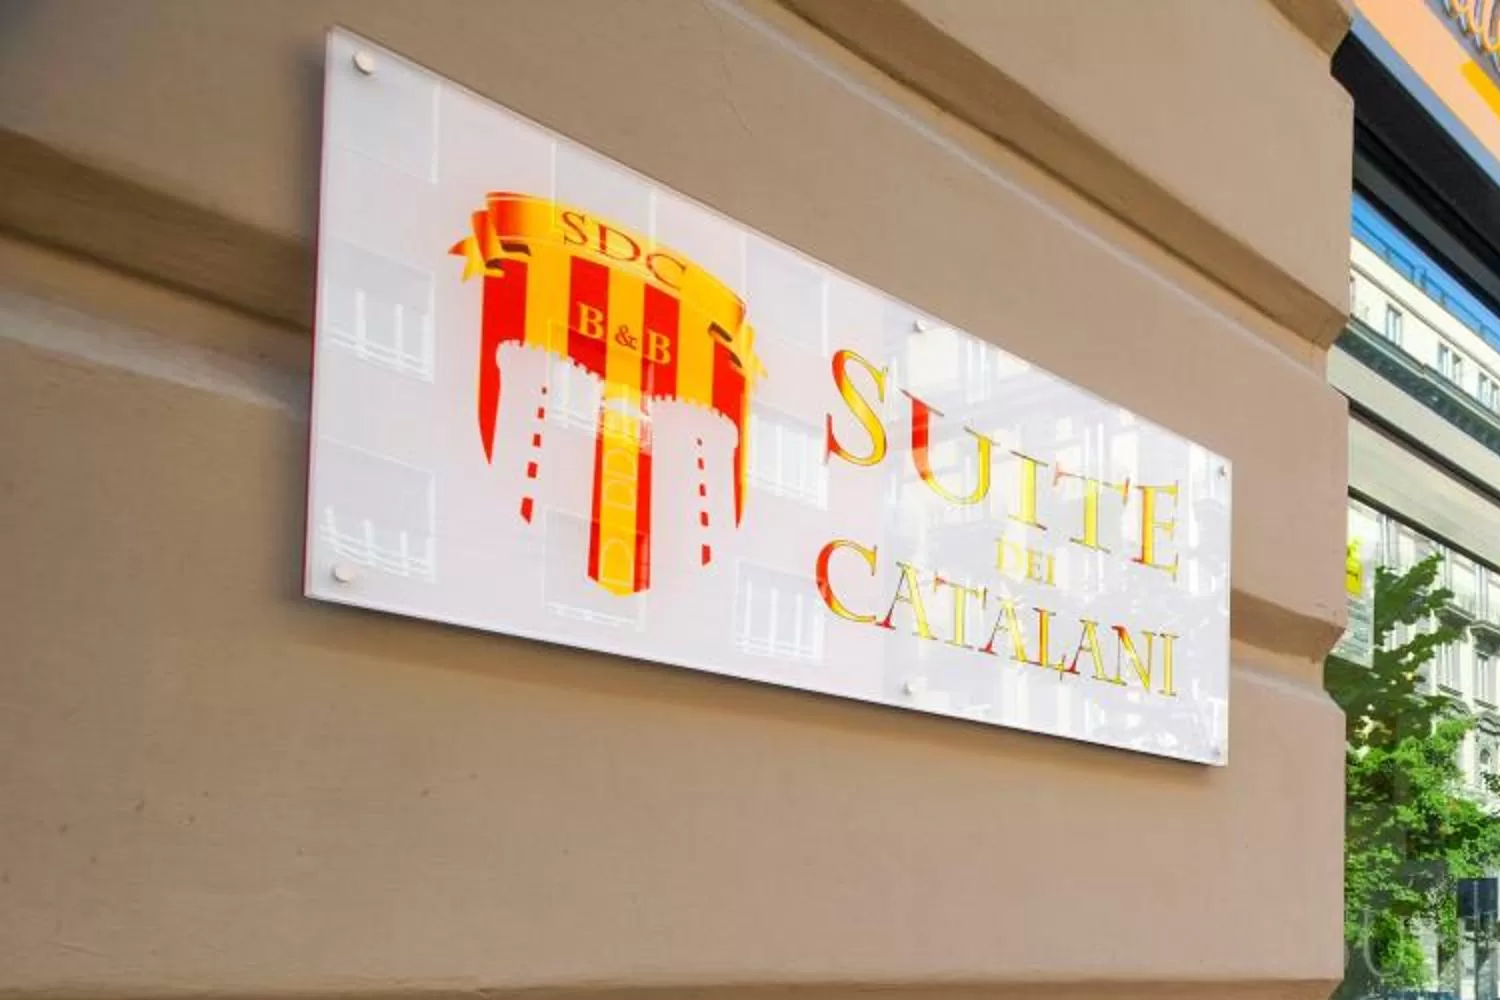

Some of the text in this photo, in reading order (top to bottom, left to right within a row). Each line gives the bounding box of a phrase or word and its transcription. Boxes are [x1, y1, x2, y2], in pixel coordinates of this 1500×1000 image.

[561, 210, 687, 291] SDC
[825, 349, 1180, 583] SUITE
[816, 539, 1180, 697] CATALANI
[995, 537, 1056, 588] DEI
